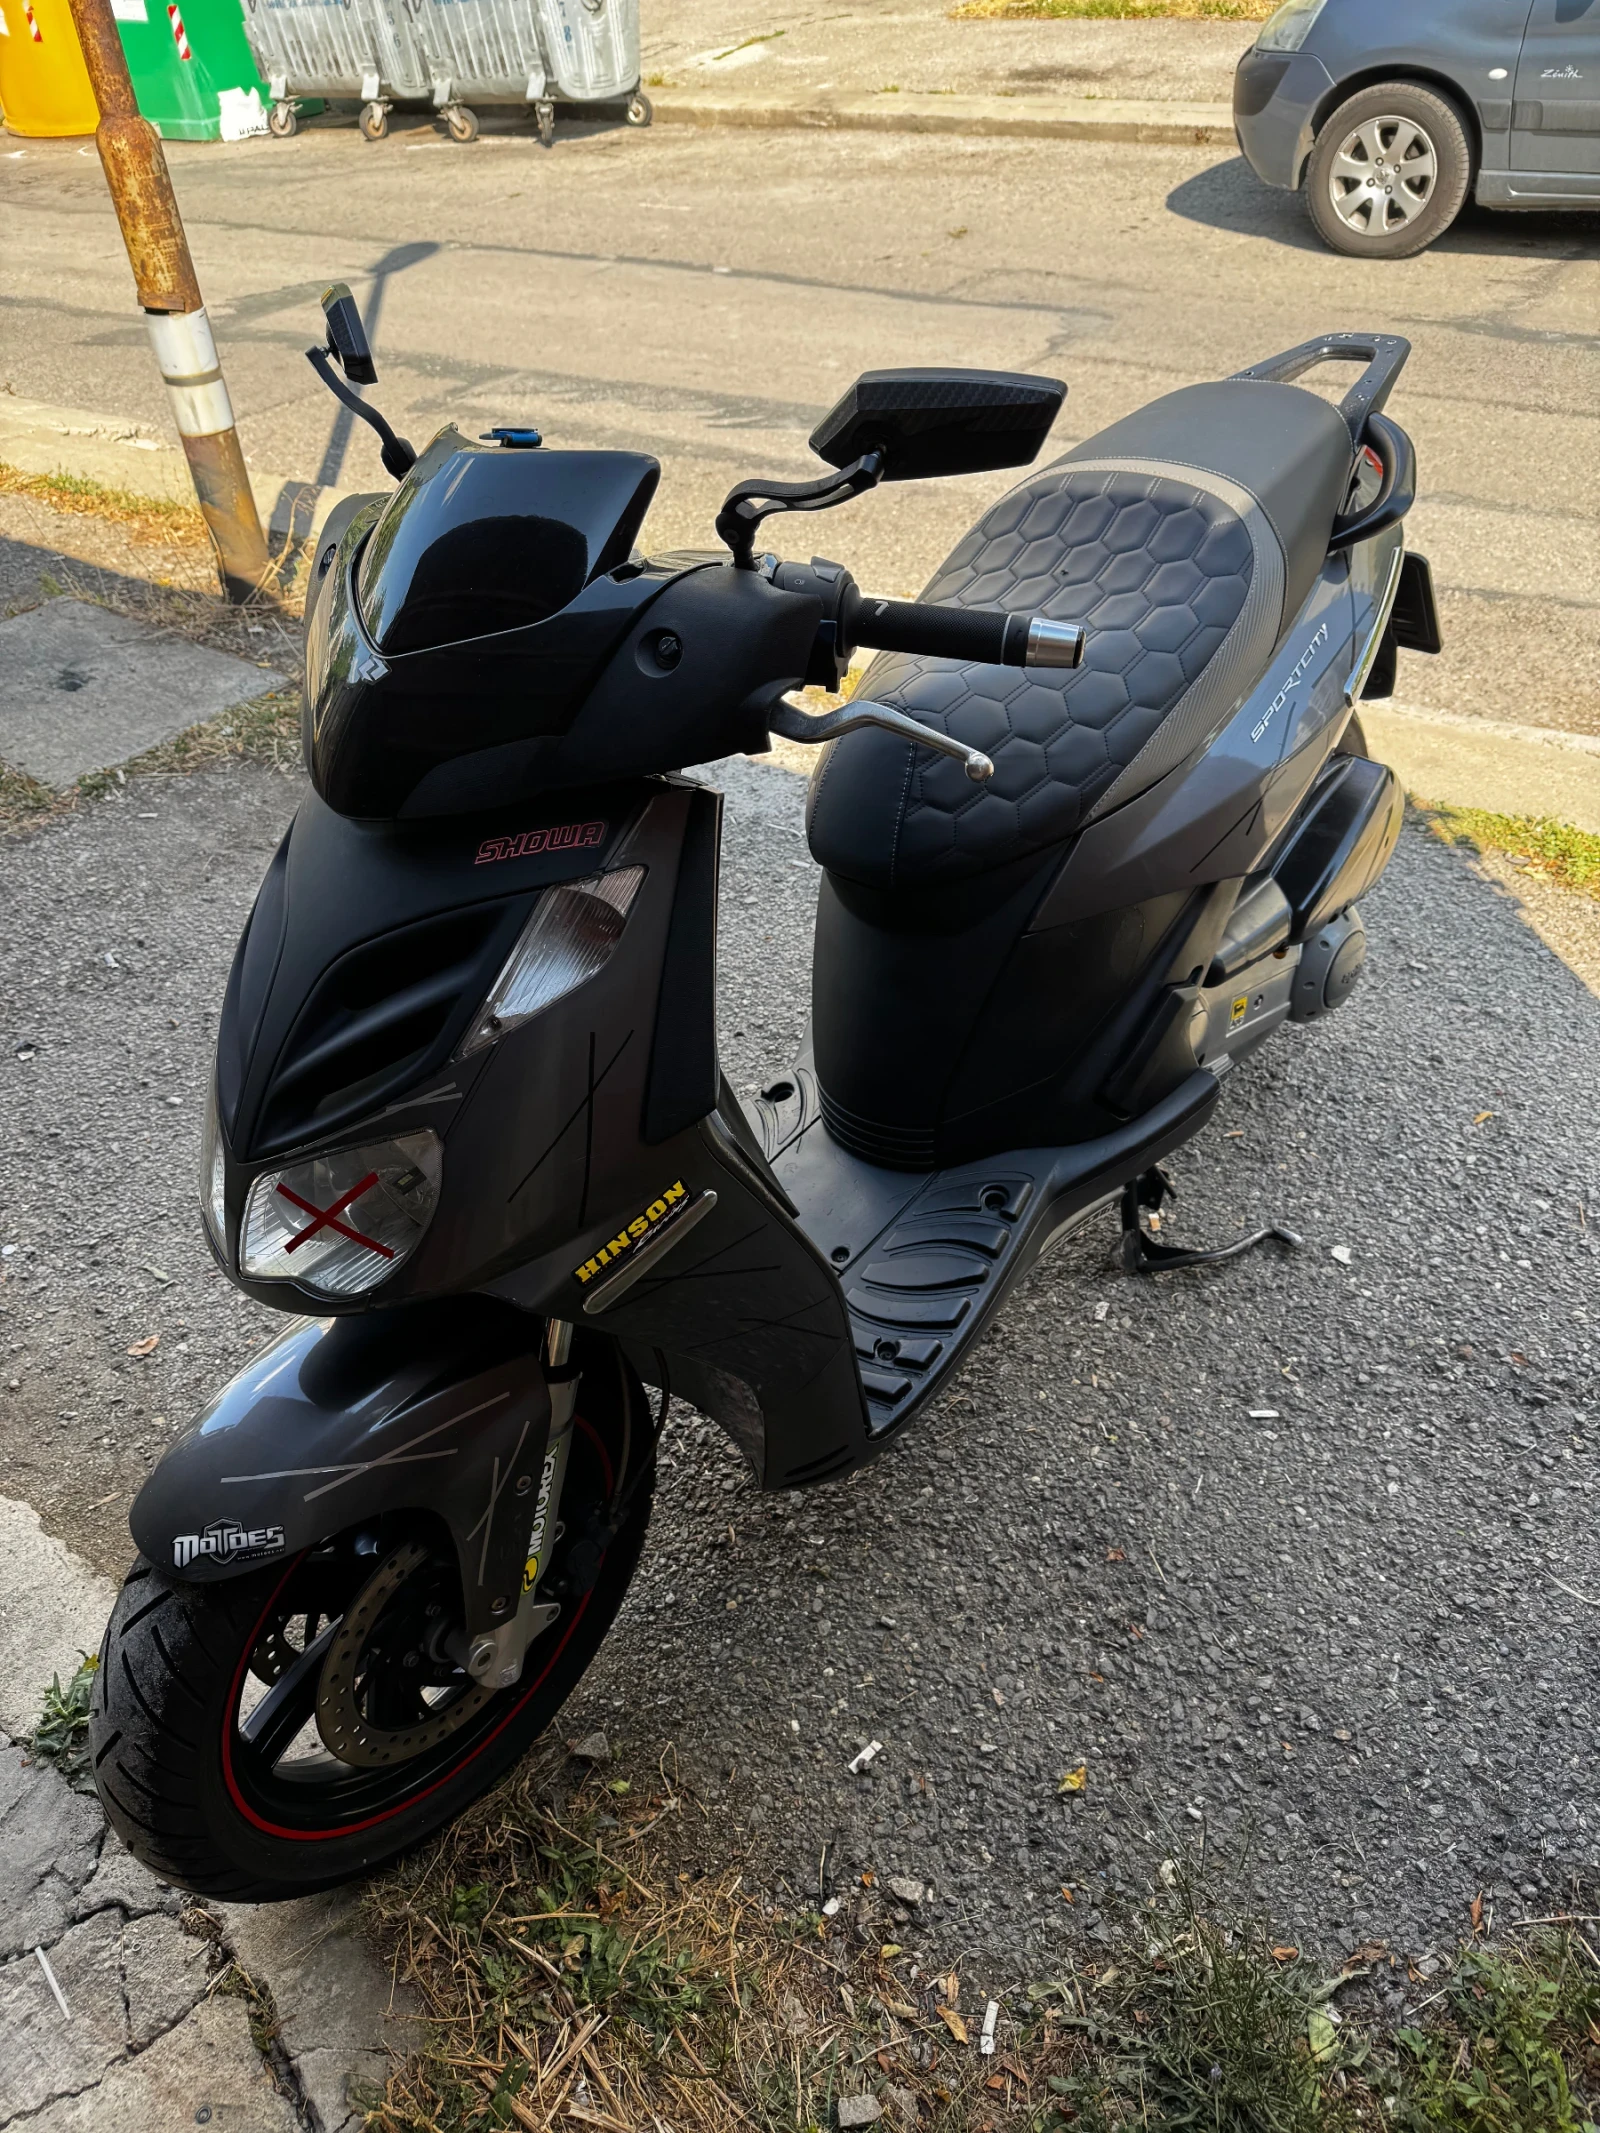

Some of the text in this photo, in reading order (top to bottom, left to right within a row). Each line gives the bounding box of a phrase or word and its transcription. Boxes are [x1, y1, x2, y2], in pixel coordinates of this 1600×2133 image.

[1250, 622, 1328, 743] SPORTCITY
[474, 821, 605, 864] SHOWA
[575, 1180, 685, 1283] HINSON
